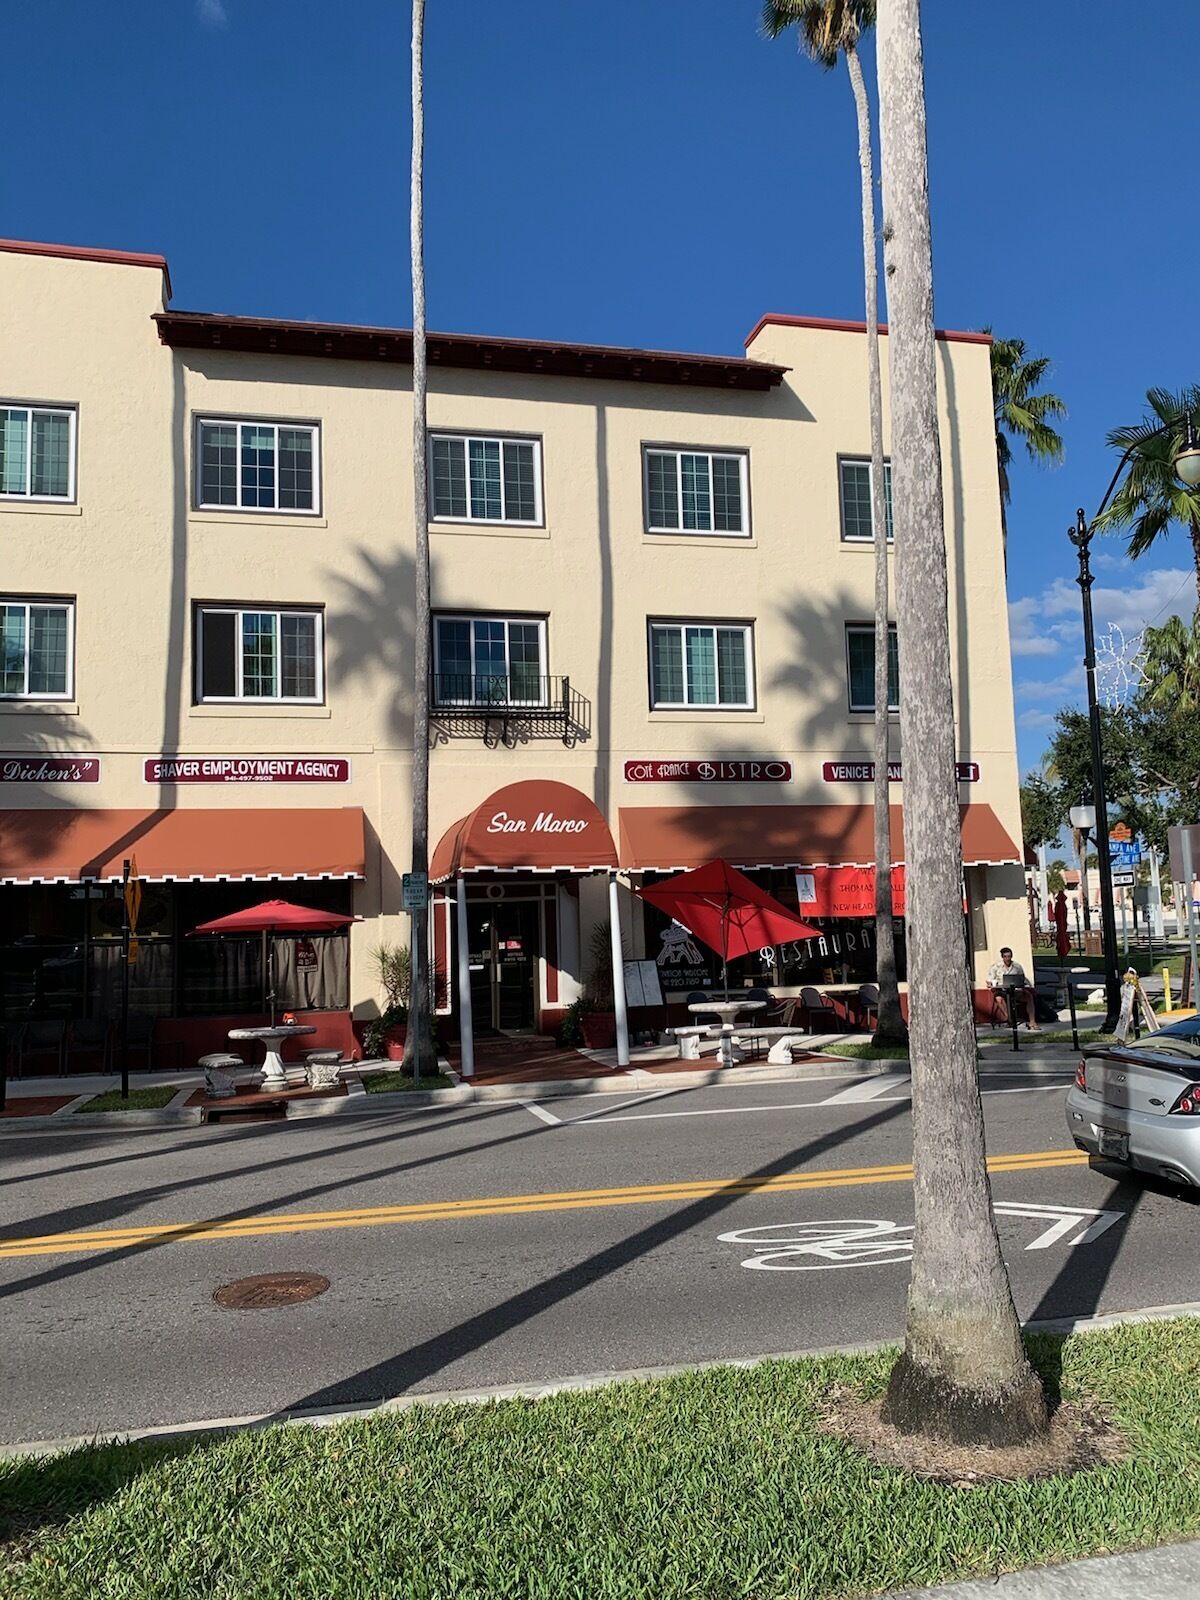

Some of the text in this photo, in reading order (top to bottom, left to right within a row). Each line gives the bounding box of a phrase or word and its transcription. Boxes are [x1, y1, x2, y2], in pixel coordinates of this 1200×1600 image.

[153, 760, 340, 779] SHAVER EMPLOYMENT AGENCY
[657, 762, 690, 777] FRANCE
[697, 762, 787, 781] BISTRO
[831, 766, 869, 779] VENICE
[486, 811, 589, 833] San Marco
[839, 883, 875, 892] THOMAS
[833, 903, 850, 911] NEW
[852, 902, 873, 910] HEAD
